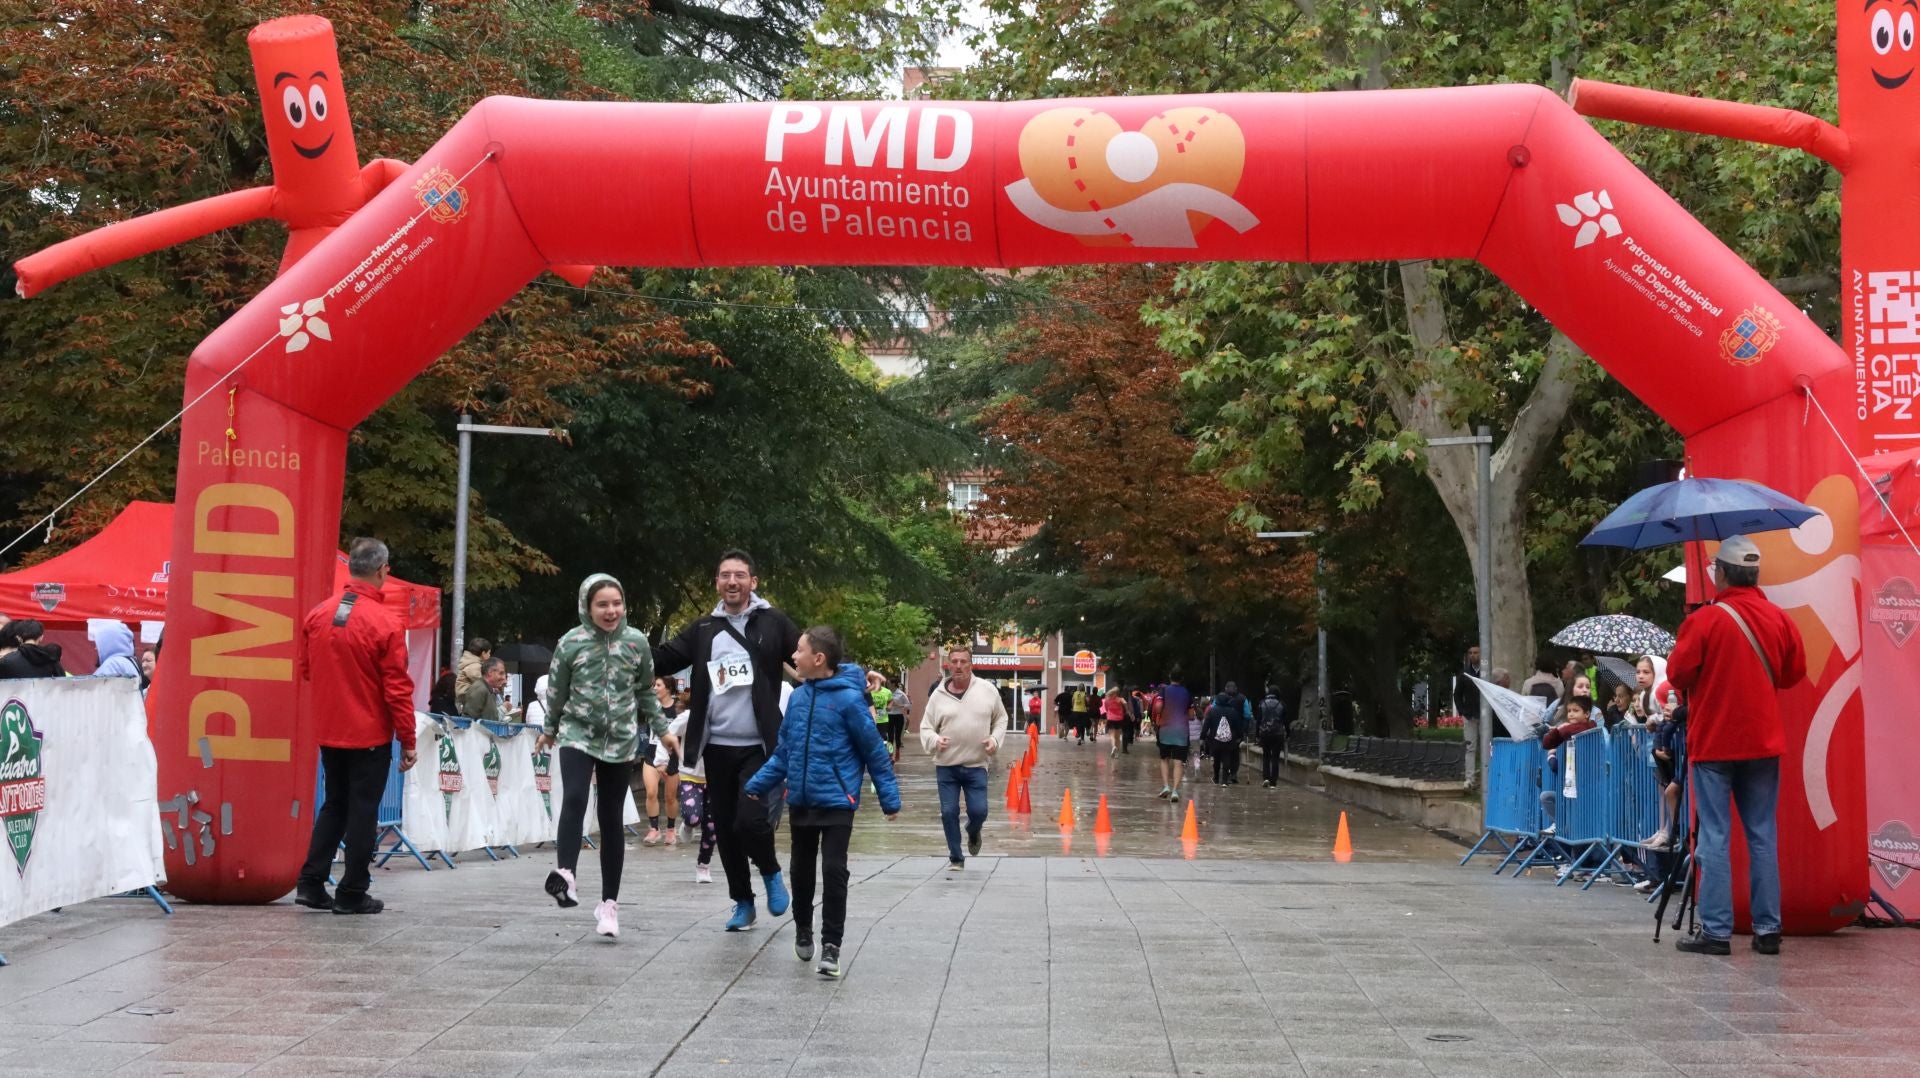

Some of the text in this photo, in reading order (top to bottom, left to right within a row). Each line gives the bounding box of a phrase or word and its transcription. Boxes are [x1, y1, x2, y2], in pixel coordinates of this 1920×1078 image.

[765, 104, 973, 172] PMD
[765, 167, 969, 208] Ayuntamiento
[766, 201, 972, 242] de Palencia
[328, 216, 417, 298] Patronato Municipal
[345, 236, 434, 317] Ayuntamiento de Palencia
[354, 243, 409, 293] de Deportes
[1622, 236, 1723, 317] Patronato Municipal
[1603, 258, 1703, 337] Ayuntamiento de Palencia
[1631, 264, 1693, 313] de Deportes
[1853, 269, 1868, 421] AYUNTAMIENTO
[1871, 354, 1893, 413] CIA
[1892, 354, 1912, 420] LEN
[198, 441, 301, 471] Palencia
[107, 584, 168, 600] SAB
[188, 483, 295, 762] PMD
[728, 664, 749, 677] 64
[971, 657, 1020, 665] URGER KING
